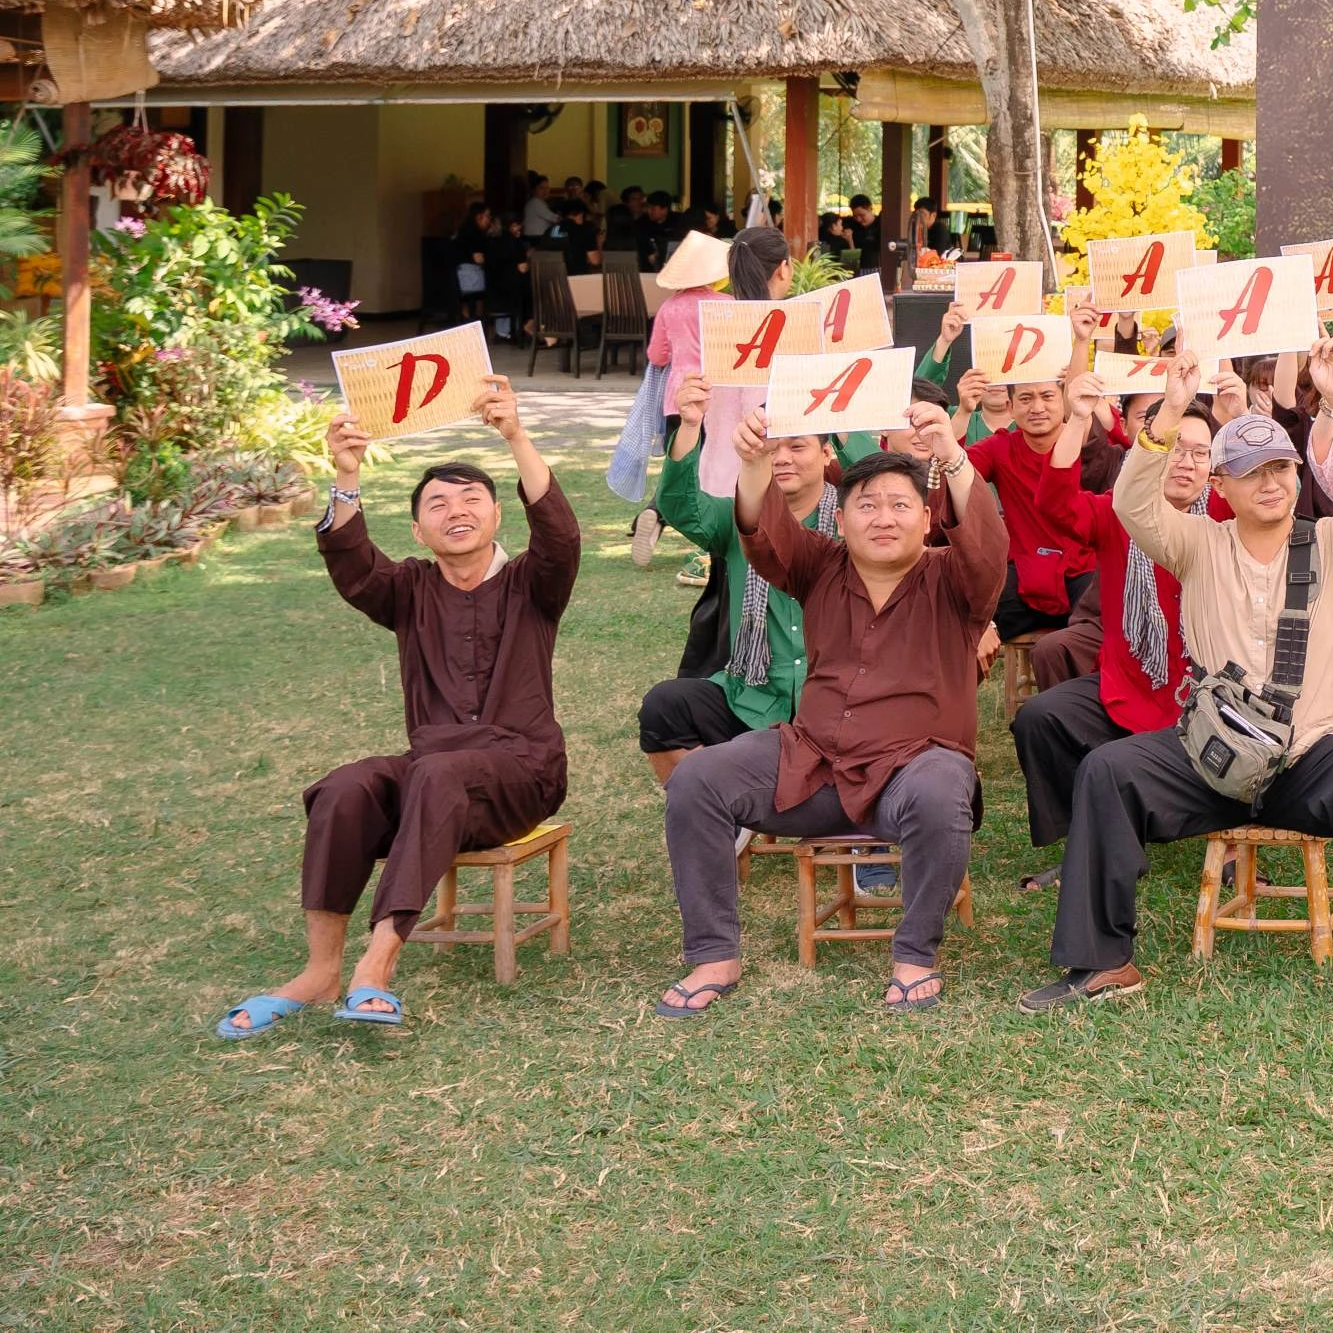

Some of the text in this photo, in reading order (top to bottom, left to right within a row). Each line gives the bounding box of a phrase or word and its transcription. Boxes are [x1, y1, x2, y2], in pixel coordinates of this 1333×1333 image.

[978, 268, 1016, 310] A
[1119, 241, 1165, 299] A
[823, 288, 851, 343] A
[1217, 266, 1273, 340] A
[732, 308, 787, 371] A
[1001, 323, 1045, 374] D
[385, 351, 452, 425] D
[805, 357, 873, 414] A
